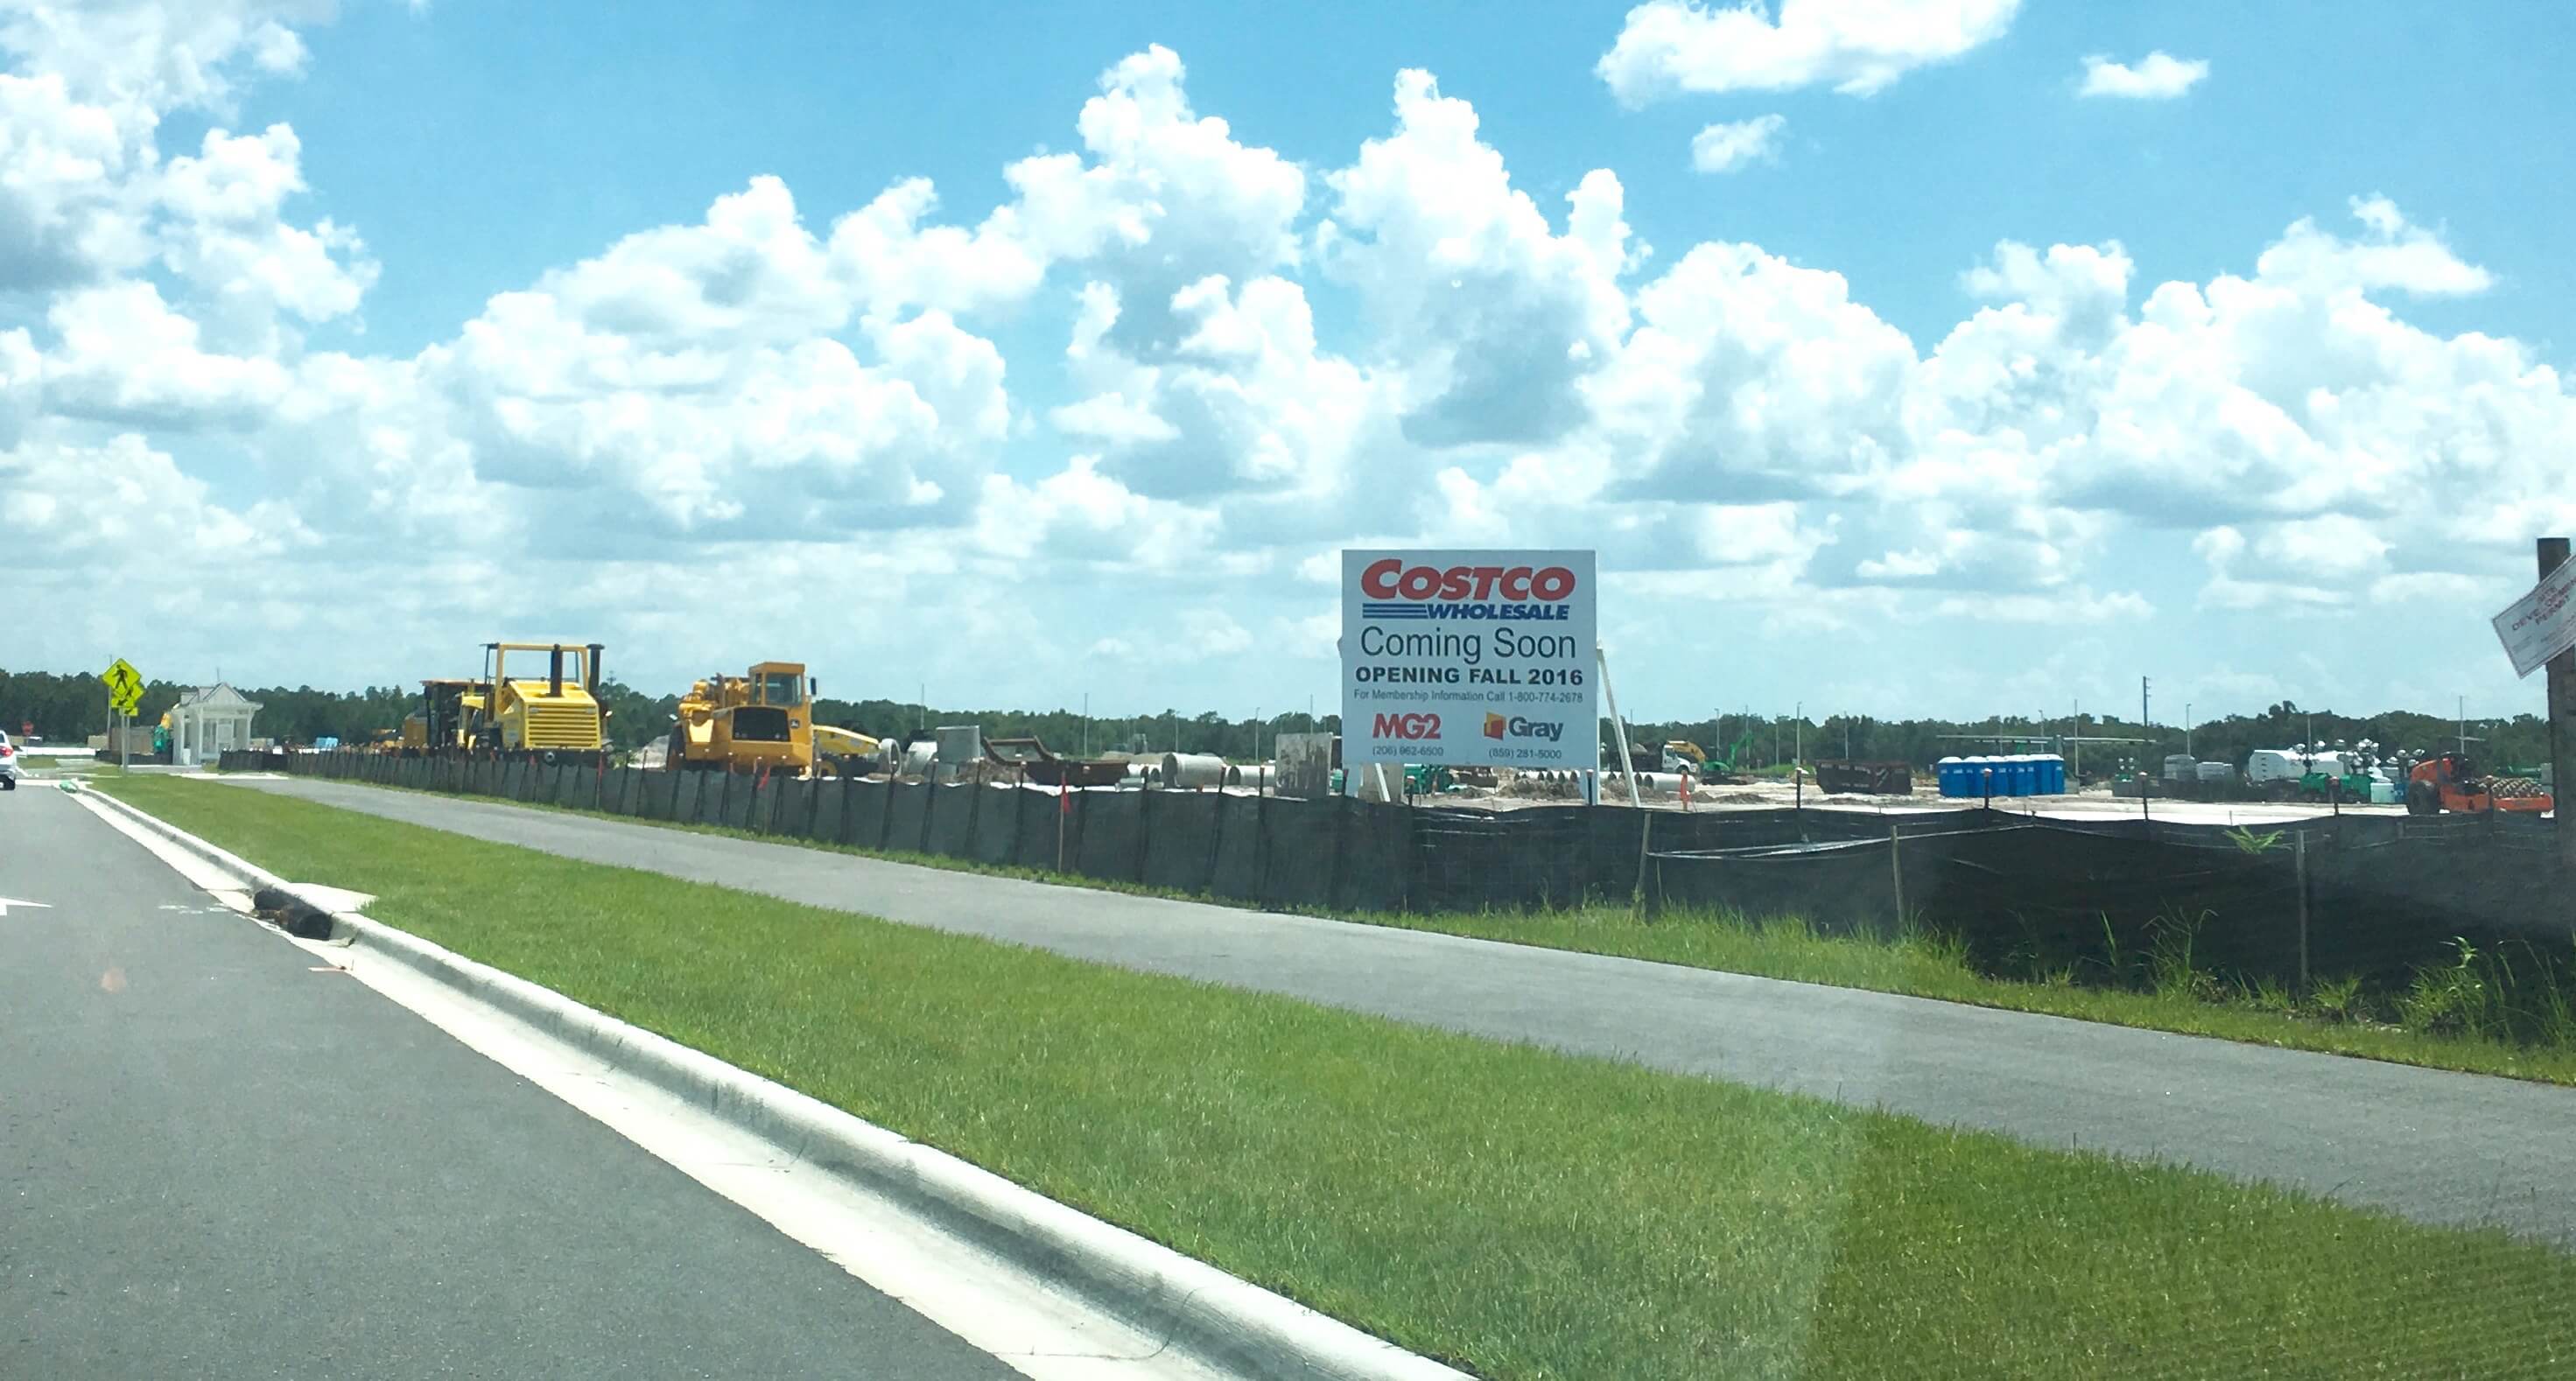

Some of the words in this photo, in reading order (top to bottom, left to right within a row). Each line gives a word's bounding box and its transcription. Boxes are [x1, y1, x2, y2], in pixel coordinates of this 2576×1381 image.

[1361, 558, 1576, 601] COSTCO
[1427, 604, 1570, 620] WHOLESALE
[1360, 626, 1482, 665] Coming
[1493, 627, 1576, 659] Soon
[1356, 666, 1460, 684] OPENING
[1469, 669, 1521, 685] FALL
[1527, 669, 1583, 686] 2016
[1353, 688, 1370, 700] For
[1372, 689, 1428, 703] Membership
[1431, 690, 1484, 702] Information
[1486, 690, 1506, 702] Call
[1372, 712, 1442, 740] MG2
[1508, 716, 1563, 741] Gray
[1372, 746, 1397, 757] (206)
